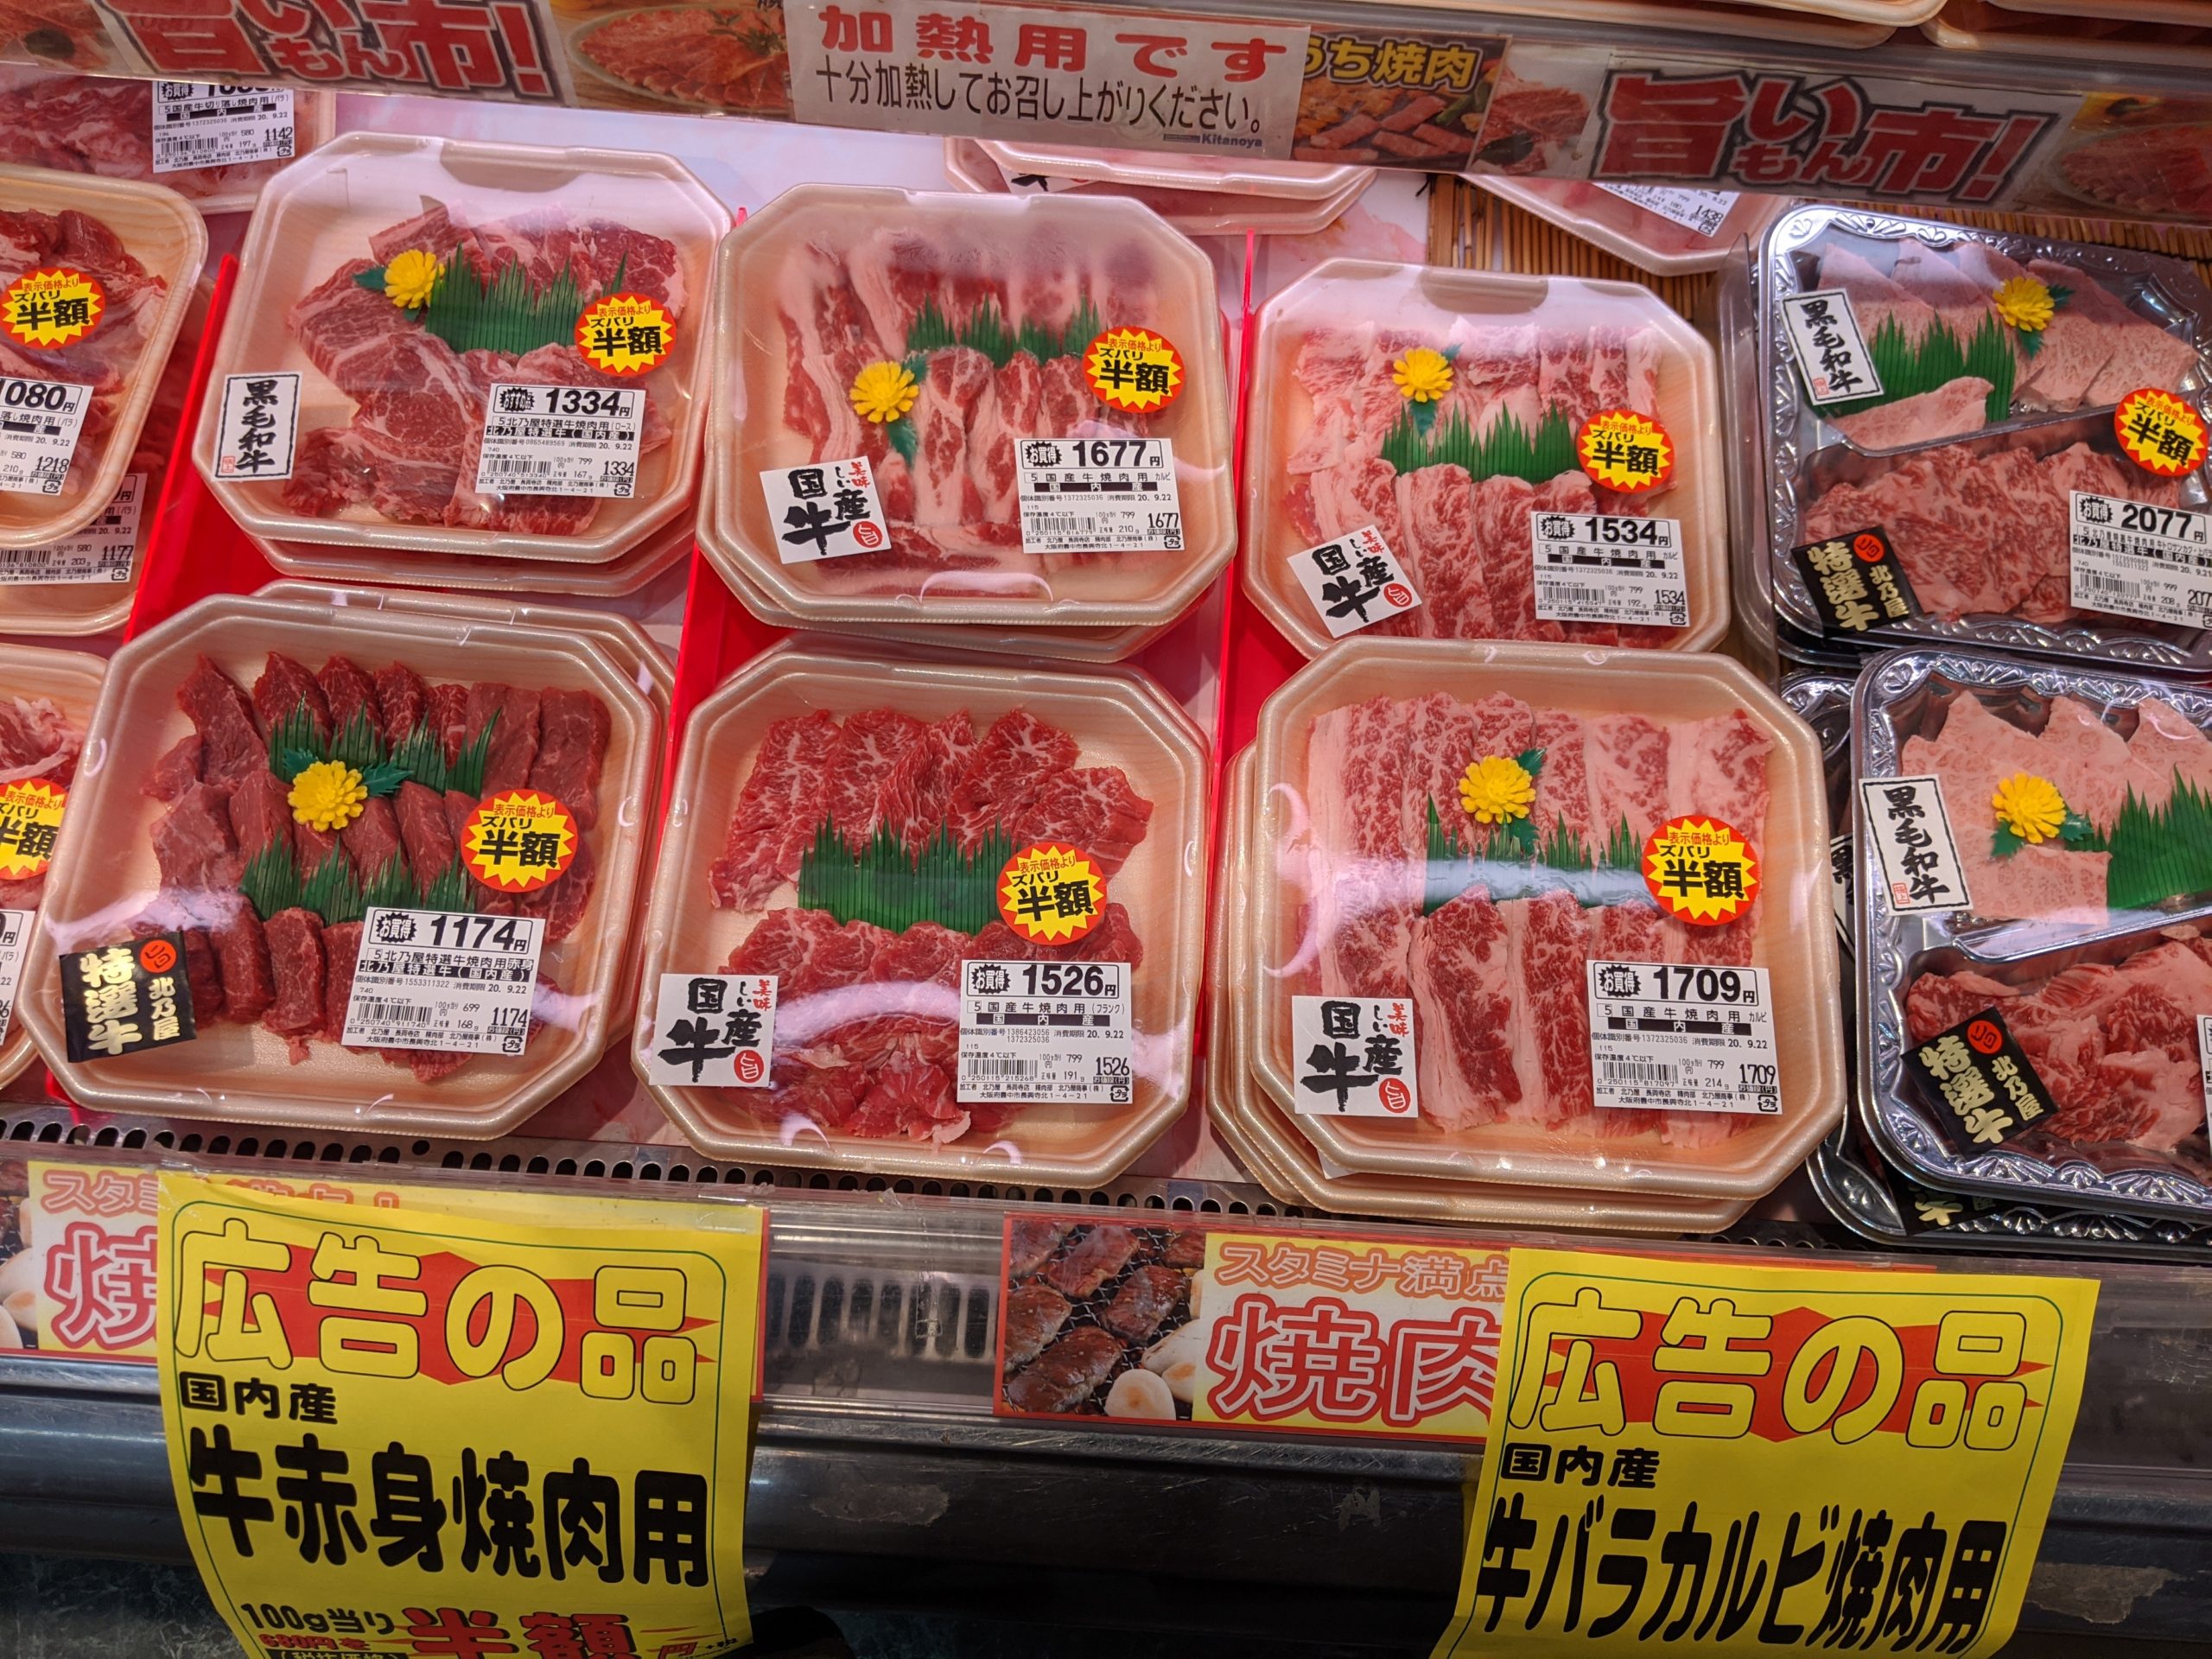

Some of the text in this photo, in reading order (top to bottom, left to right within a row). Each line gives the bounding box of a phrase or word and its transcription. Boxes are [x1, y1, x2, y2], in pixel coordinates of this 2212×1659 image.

[818, 5, 1287, 82] 加熱用です
[816, 54, 1261, 133] 十分加熱してお召し上がりください。
[265, 127, 292, 141] 1142
[1201, 131, 1263, 148] Kitanoya
[1695, 205, 1723, 223] 1438
[15, 289, 60, 302] ズバリ
[16, 297, 89, 331] 半額
[591, 316, 634, 327] ズバリ
[593, 327, 662, 357] 半額
[1800, 300, 1863, 393] 黒毛和牛
[1100, 347, 1143, 360] ズバリ
[1099, 359, 1169, 395] 半額
[235, 379, 279, 473] 黒毛和牛
[1592, 429, 1634, 442] ズバリ
[2127, 414, 2194, 466] 半額
[11, 451, 26, 460] 580
[36, 456, 68, 473] 1218
[1030, 446, 1057, 463] お買得
[1592, 442, 1659, 476] 半額
[604, 461, 634, 476] 1334
[1147, 513, 1179, 528] 1677
[2083, 501, 2109, 521] お買得
[1543, 519, 1571, 537] お買得
[102, 545, 134, 561] 1177
[1807, 542, 1878, 631] 特選牛
[1655, 590, 1686, 605] 1534
[494, 804, 554, 818] 表示価格より
[482, 817, 532, 829] ズバリ
[479, 830, 561, 868] 半額
[1669, 832, 1729, 846] 表示価格より
[1883, 785, 1949, 904] 黒毛和牛
[1660, 845, 1710, 858] ズバリ
[1020, 856, 1076, 874] 表示価格より
[1012, 870, 1058, 887] ズバリ
[1663, 859, 1745, 899] 半額
[1018, 880, 1094, 922] 半額
[378, 918, 411, 938] お買得
[507, 985, 526, 994] 9.22
[976, 969, 1006, 990] お買得
[1603, 971, 1637, 993] お買得
[79, 948, 143, 1055] 特選牛
[463, 1003, 480, 1012] 699
[491, 1007, 528, 1027] 1174
[1692, 1038, 1726, 1046] 消費期限
[1747, 1040, 1768, 1049] 9.22
[1066, 1054, 1082, 1063] 799
[1096, 1057, 1129, 1076] 1526
[1707, 1060, 1725, 1070] 799
[1065, 1071, 1077, 1080] 191
[1705, 1077, 1721, 1088] 214
[1738, 1064, 1776, 1084] 1709
[1919, 1035, 2012, 1143] 特選牛
[1216, 1243, 1508, 1299] スタミナ満点
[175, 1217, 696, 1404] 広告の品
[1206, 1294, 1502, 1427] 焼肉
[1507, 1287, 2028, 1451] 広告の品
[179, 1370, 339, 1426] 国内産
[1499, 1442, 1661, 1489] 国内産
[189, 1424, 710, 1587] 牛赤身焼肉用
[1474, 1491, 2009, 1655] 牛バラカルビ焼肉用
[240, 1603, 396, 1636] 100g当り
